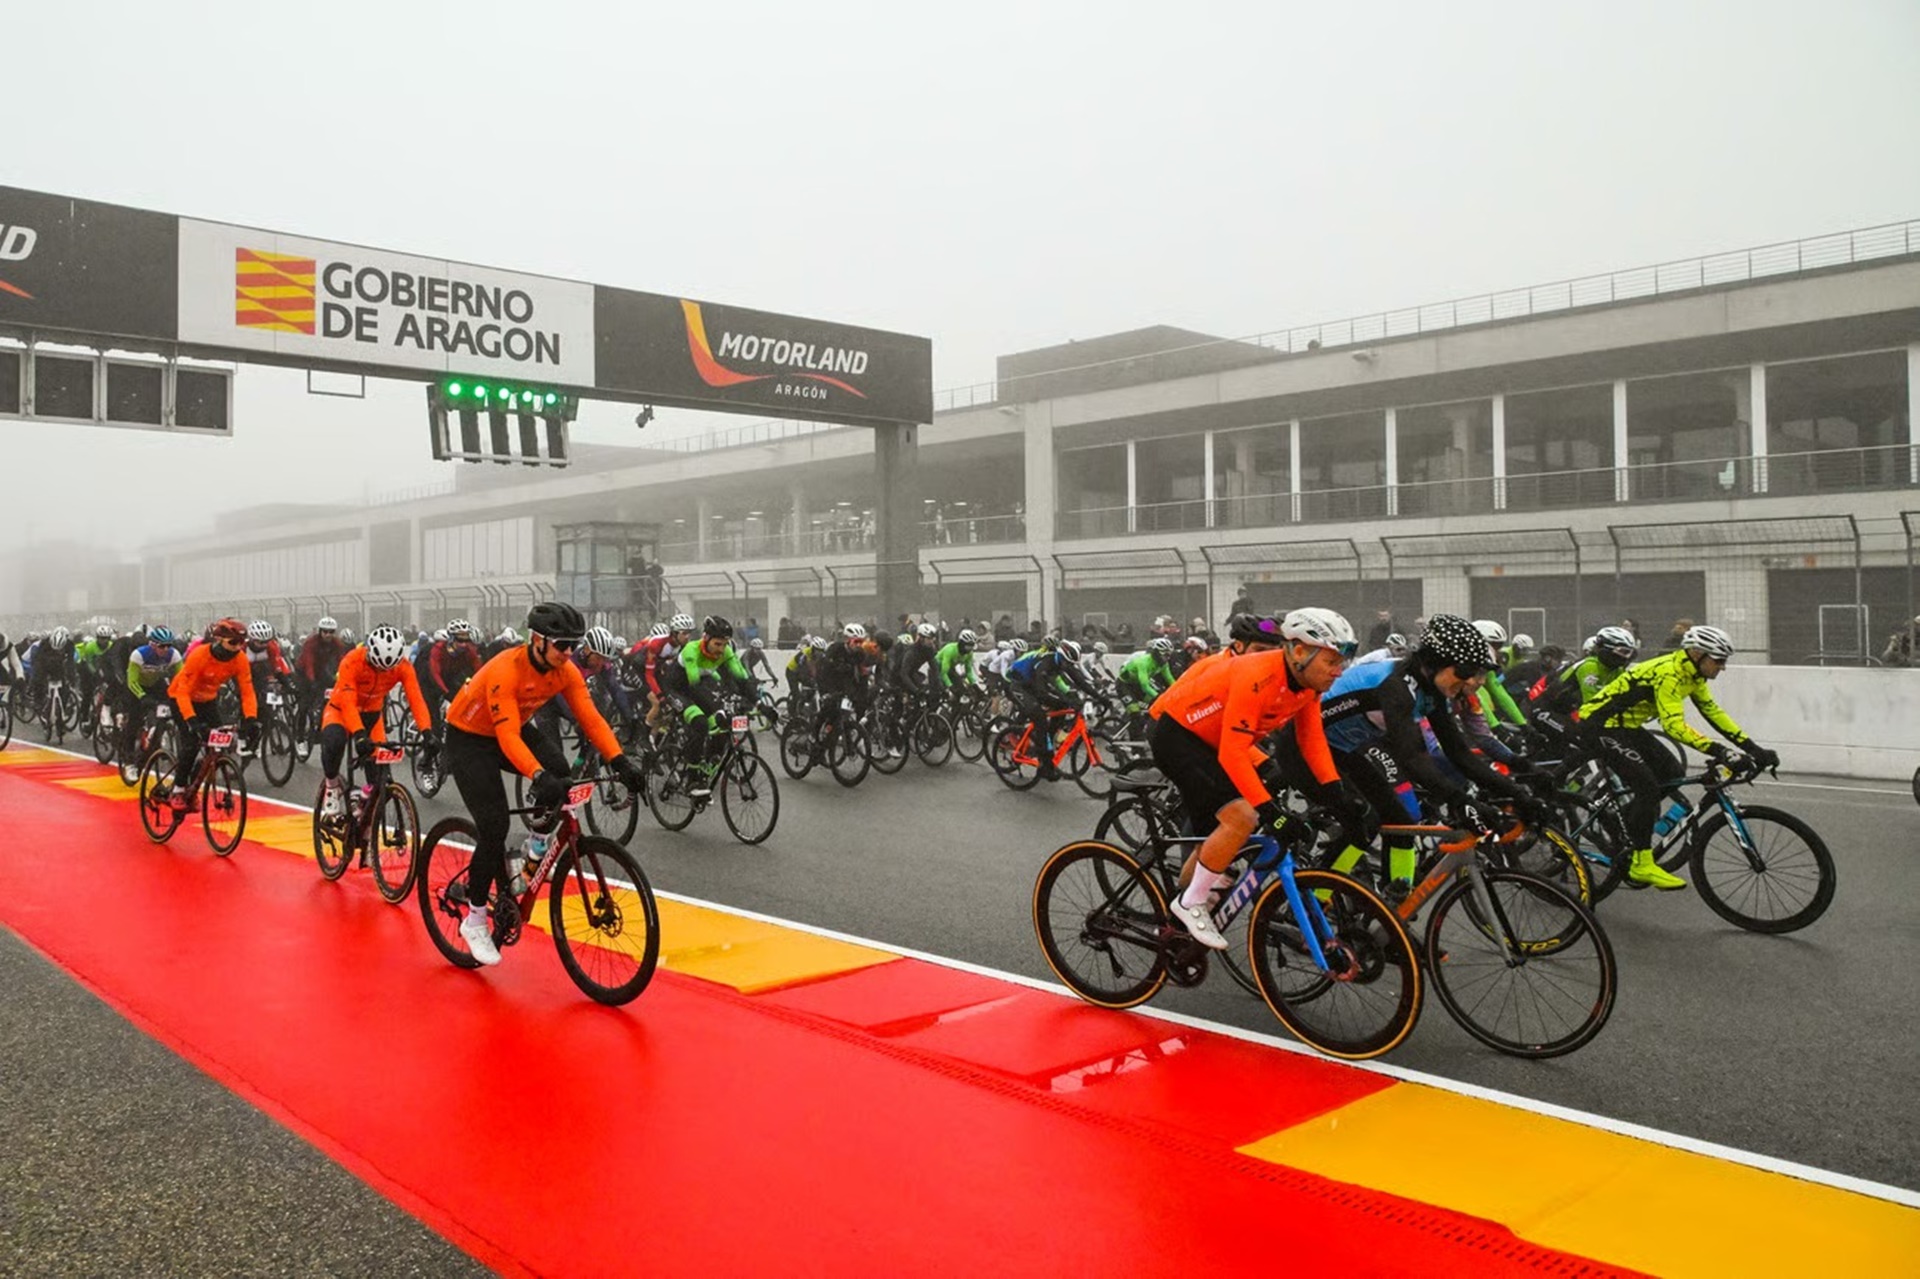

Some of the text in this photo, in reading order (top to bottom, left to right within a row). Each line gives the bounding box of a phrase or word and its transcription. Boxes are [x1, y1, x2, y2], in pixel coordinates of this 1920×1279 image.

[322, 261, 533, 324] GOBIERNO
[322, 302, 560, 365] DE ARAGON
[718, 332, 868, 375] MOTORLAND
[775, 383, 828, 399] ARAGÓN
[530, 834, 560, 894] BERRIA
[1213, 870, 1258, 930] IANT
